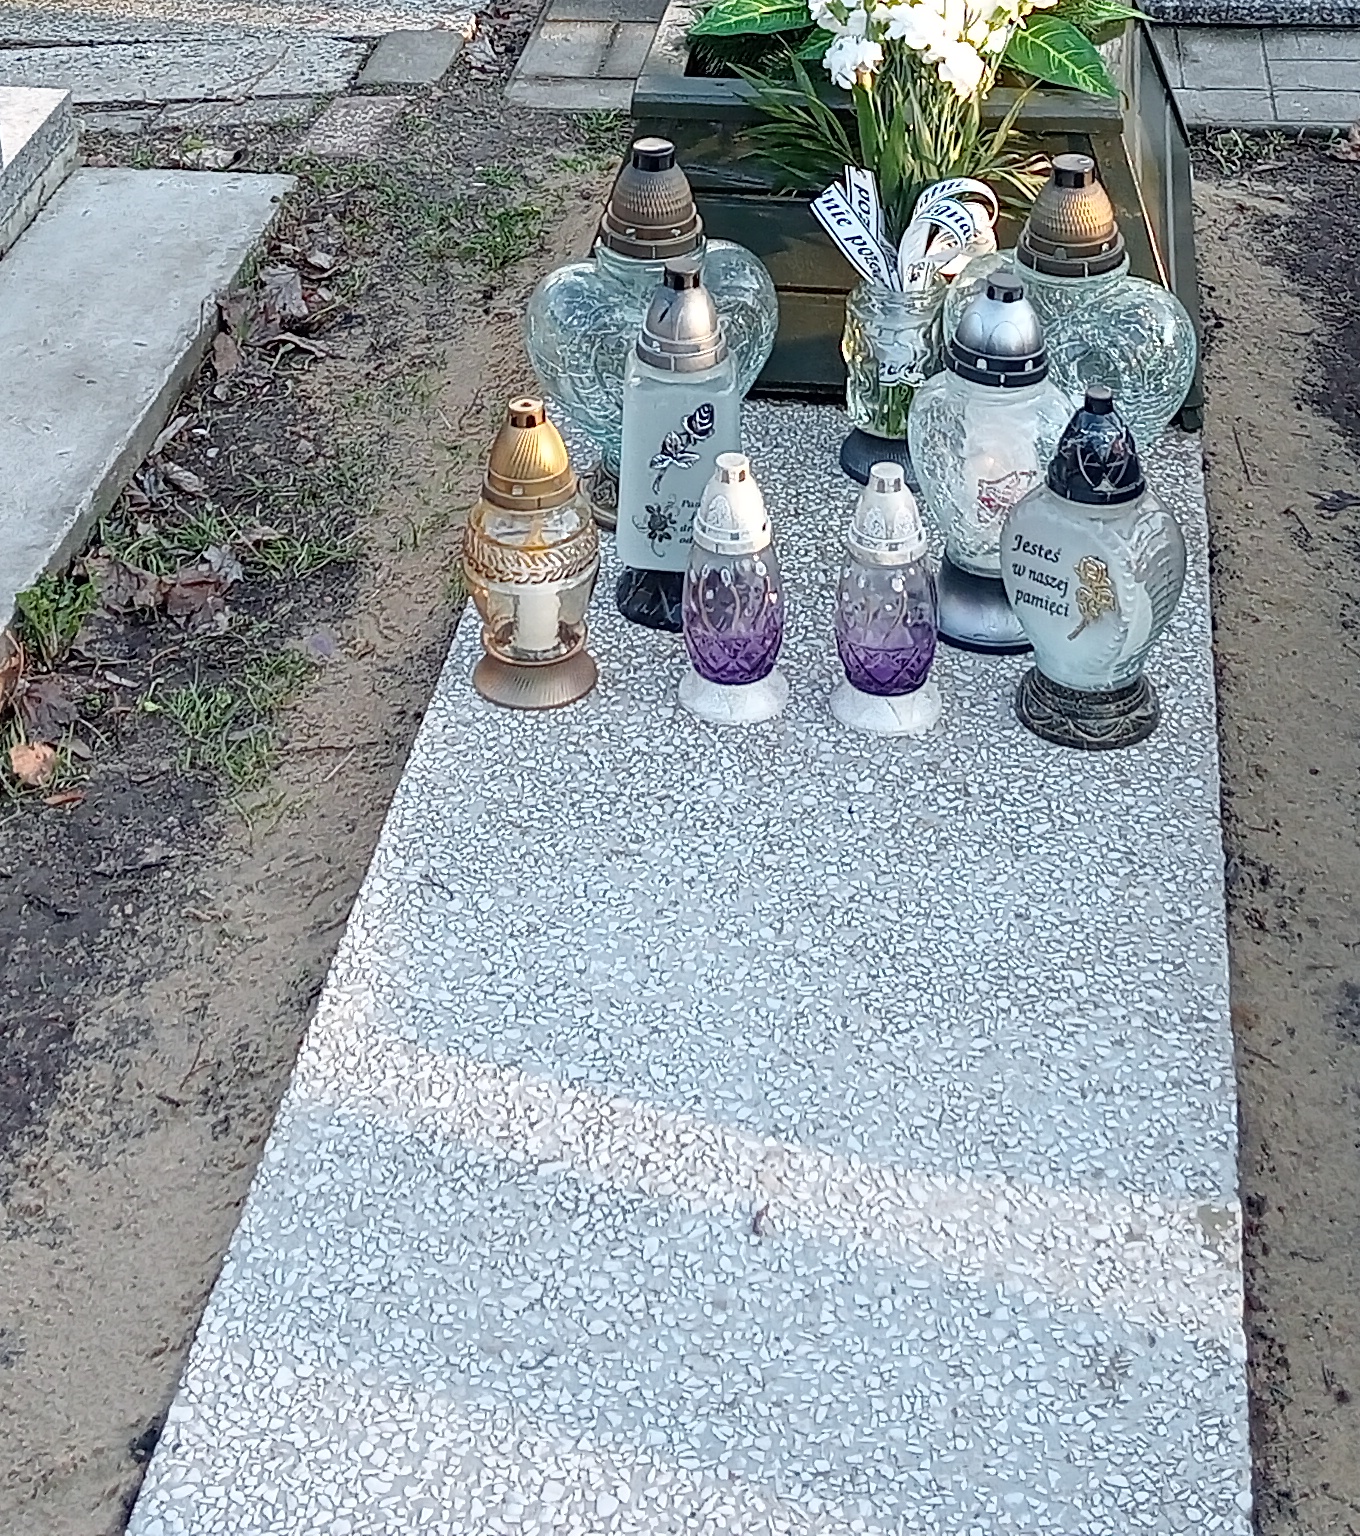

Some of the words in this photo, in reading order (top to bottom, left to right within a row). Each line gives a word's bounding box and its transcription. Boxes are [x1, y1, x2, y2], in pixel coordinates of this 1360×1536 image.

[1011, 533, 1063, 564] Jesteś
[1011, 563, 1027, 577] w
[1028, 569, 1070, 599] naszej
[1014, 588, 1071, 618] pamięci
